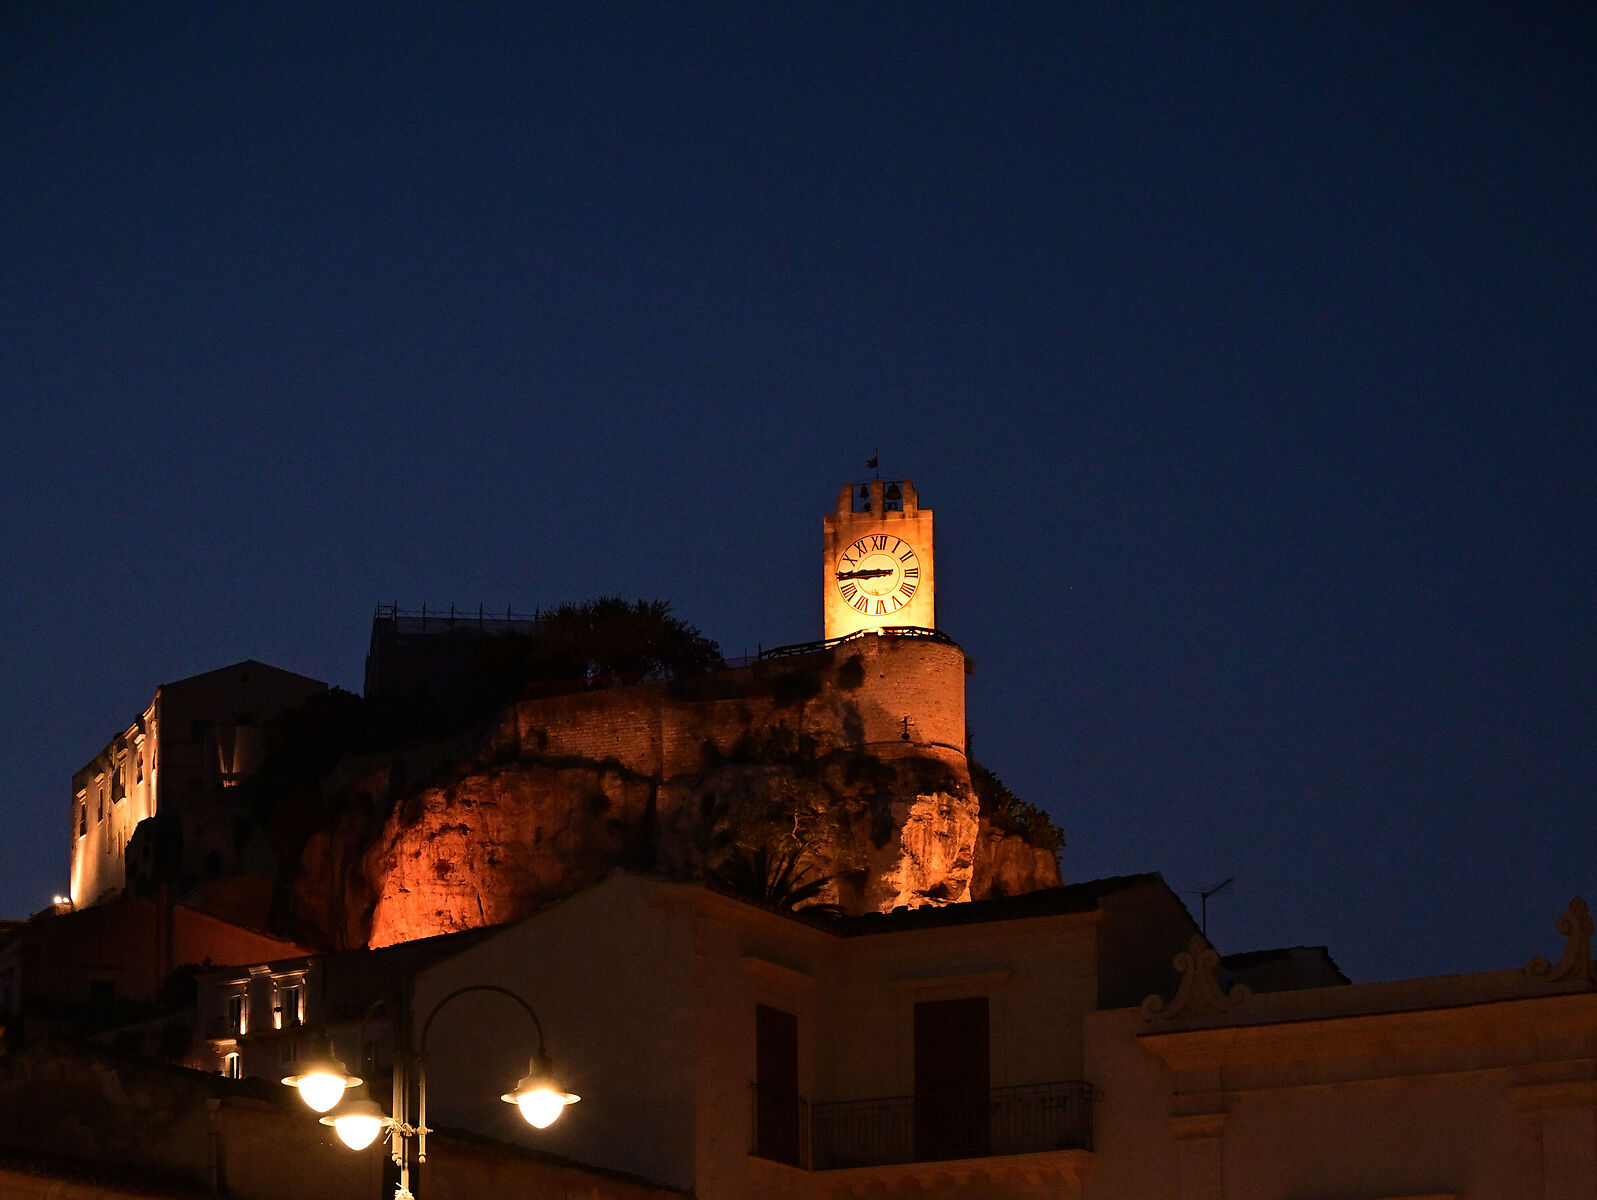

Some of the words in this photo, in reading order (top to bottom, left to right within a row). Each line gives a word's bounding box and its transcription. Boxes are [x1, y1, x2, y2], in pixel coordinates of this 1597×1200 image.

[854, 540, 868, 558] XI
[871, 536, 888, 551] XII
[892, 539, 901, 554] I
[843, 554, 858, 566] X
[899, 550, 914, 563] II
[904, 568, 918, 578] III
[840, 582, 858, 602] VIII
[899, 582, 916, 598] IIII
[854, 596, 868, 613] VII
[876, 600, 887, 614] VI
[892, 596, 903, 610] V
